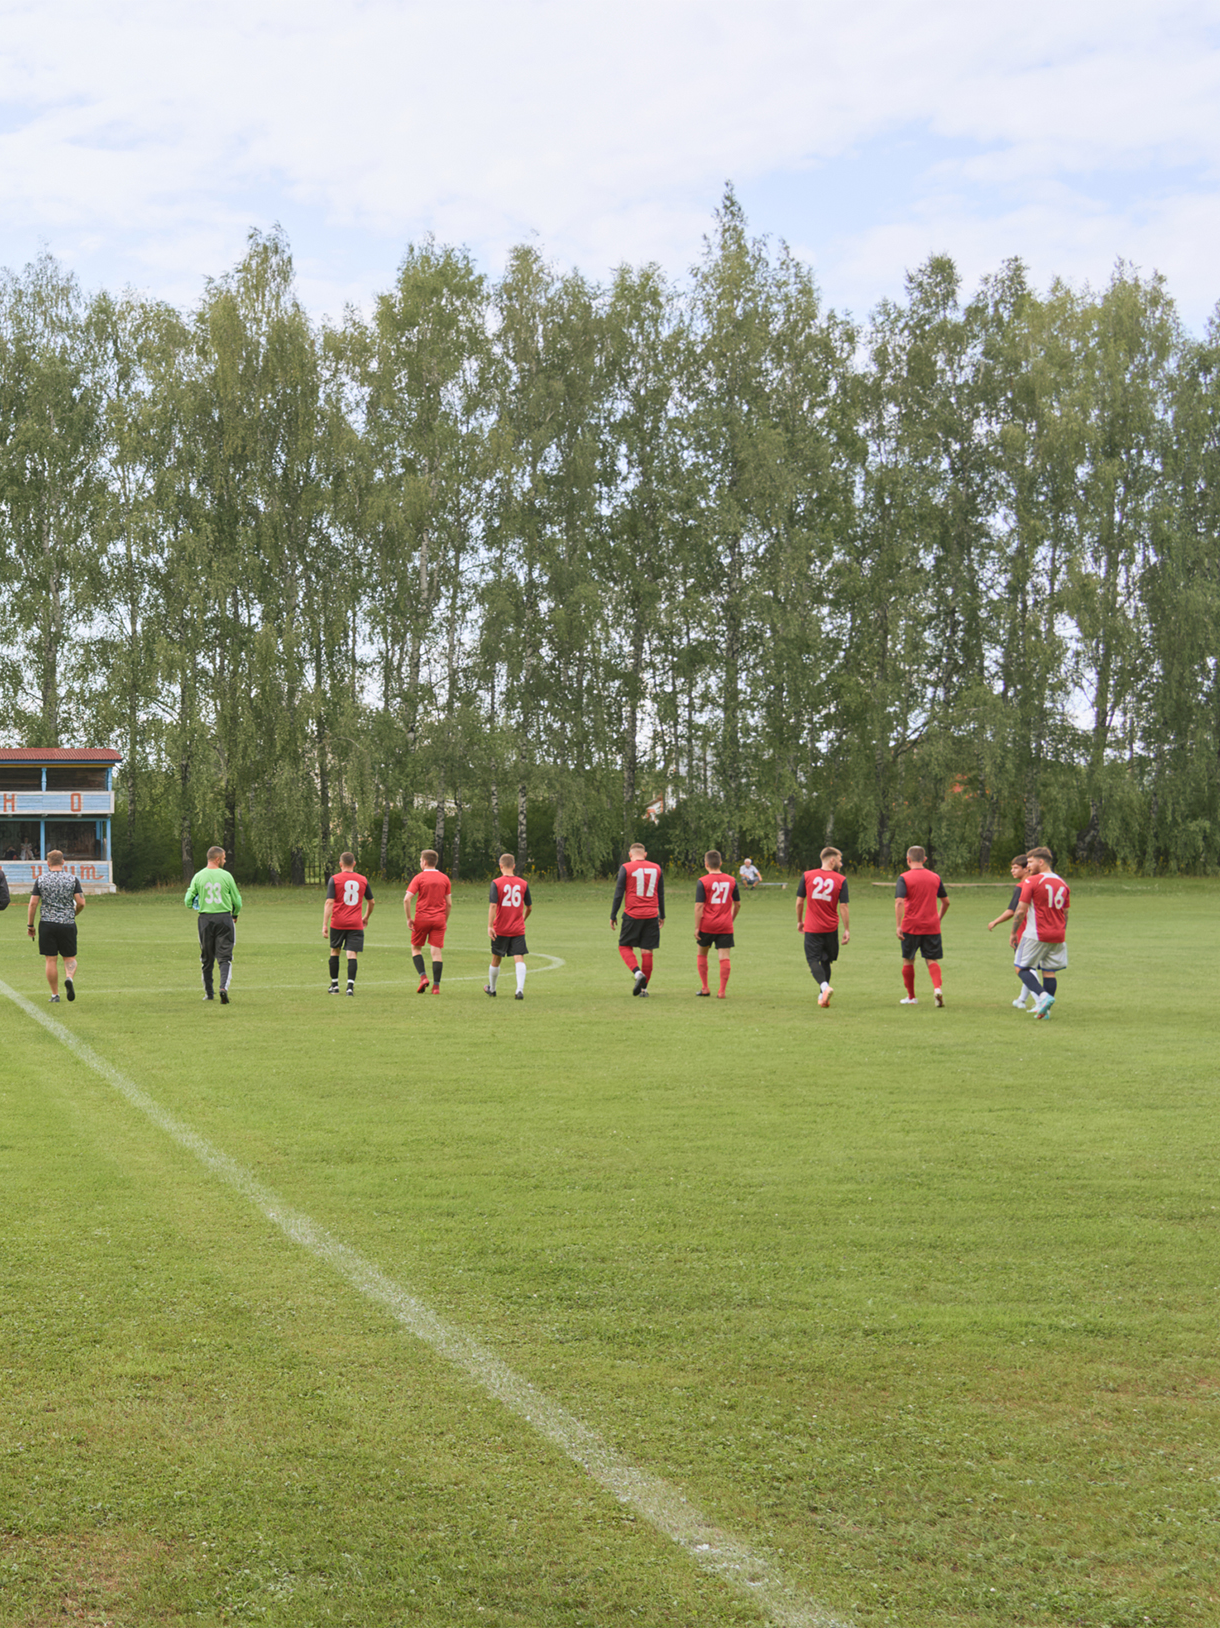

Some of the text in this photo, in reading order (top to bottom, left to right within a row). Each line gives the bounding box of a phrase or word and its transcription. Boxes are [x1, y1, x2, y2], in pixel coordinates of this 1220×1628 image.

[30, 864, 105, 880] ит
[631, 868, 657, 897] 17
[204, 882, 222, 904] 33
[343, 880, 360, 906] 8
[501, 884, 521, 907] 26
[711, 881, 730, 904] 27
[811, 876, 835, 902] 22
[1045, 884, 1066, 910] 16
